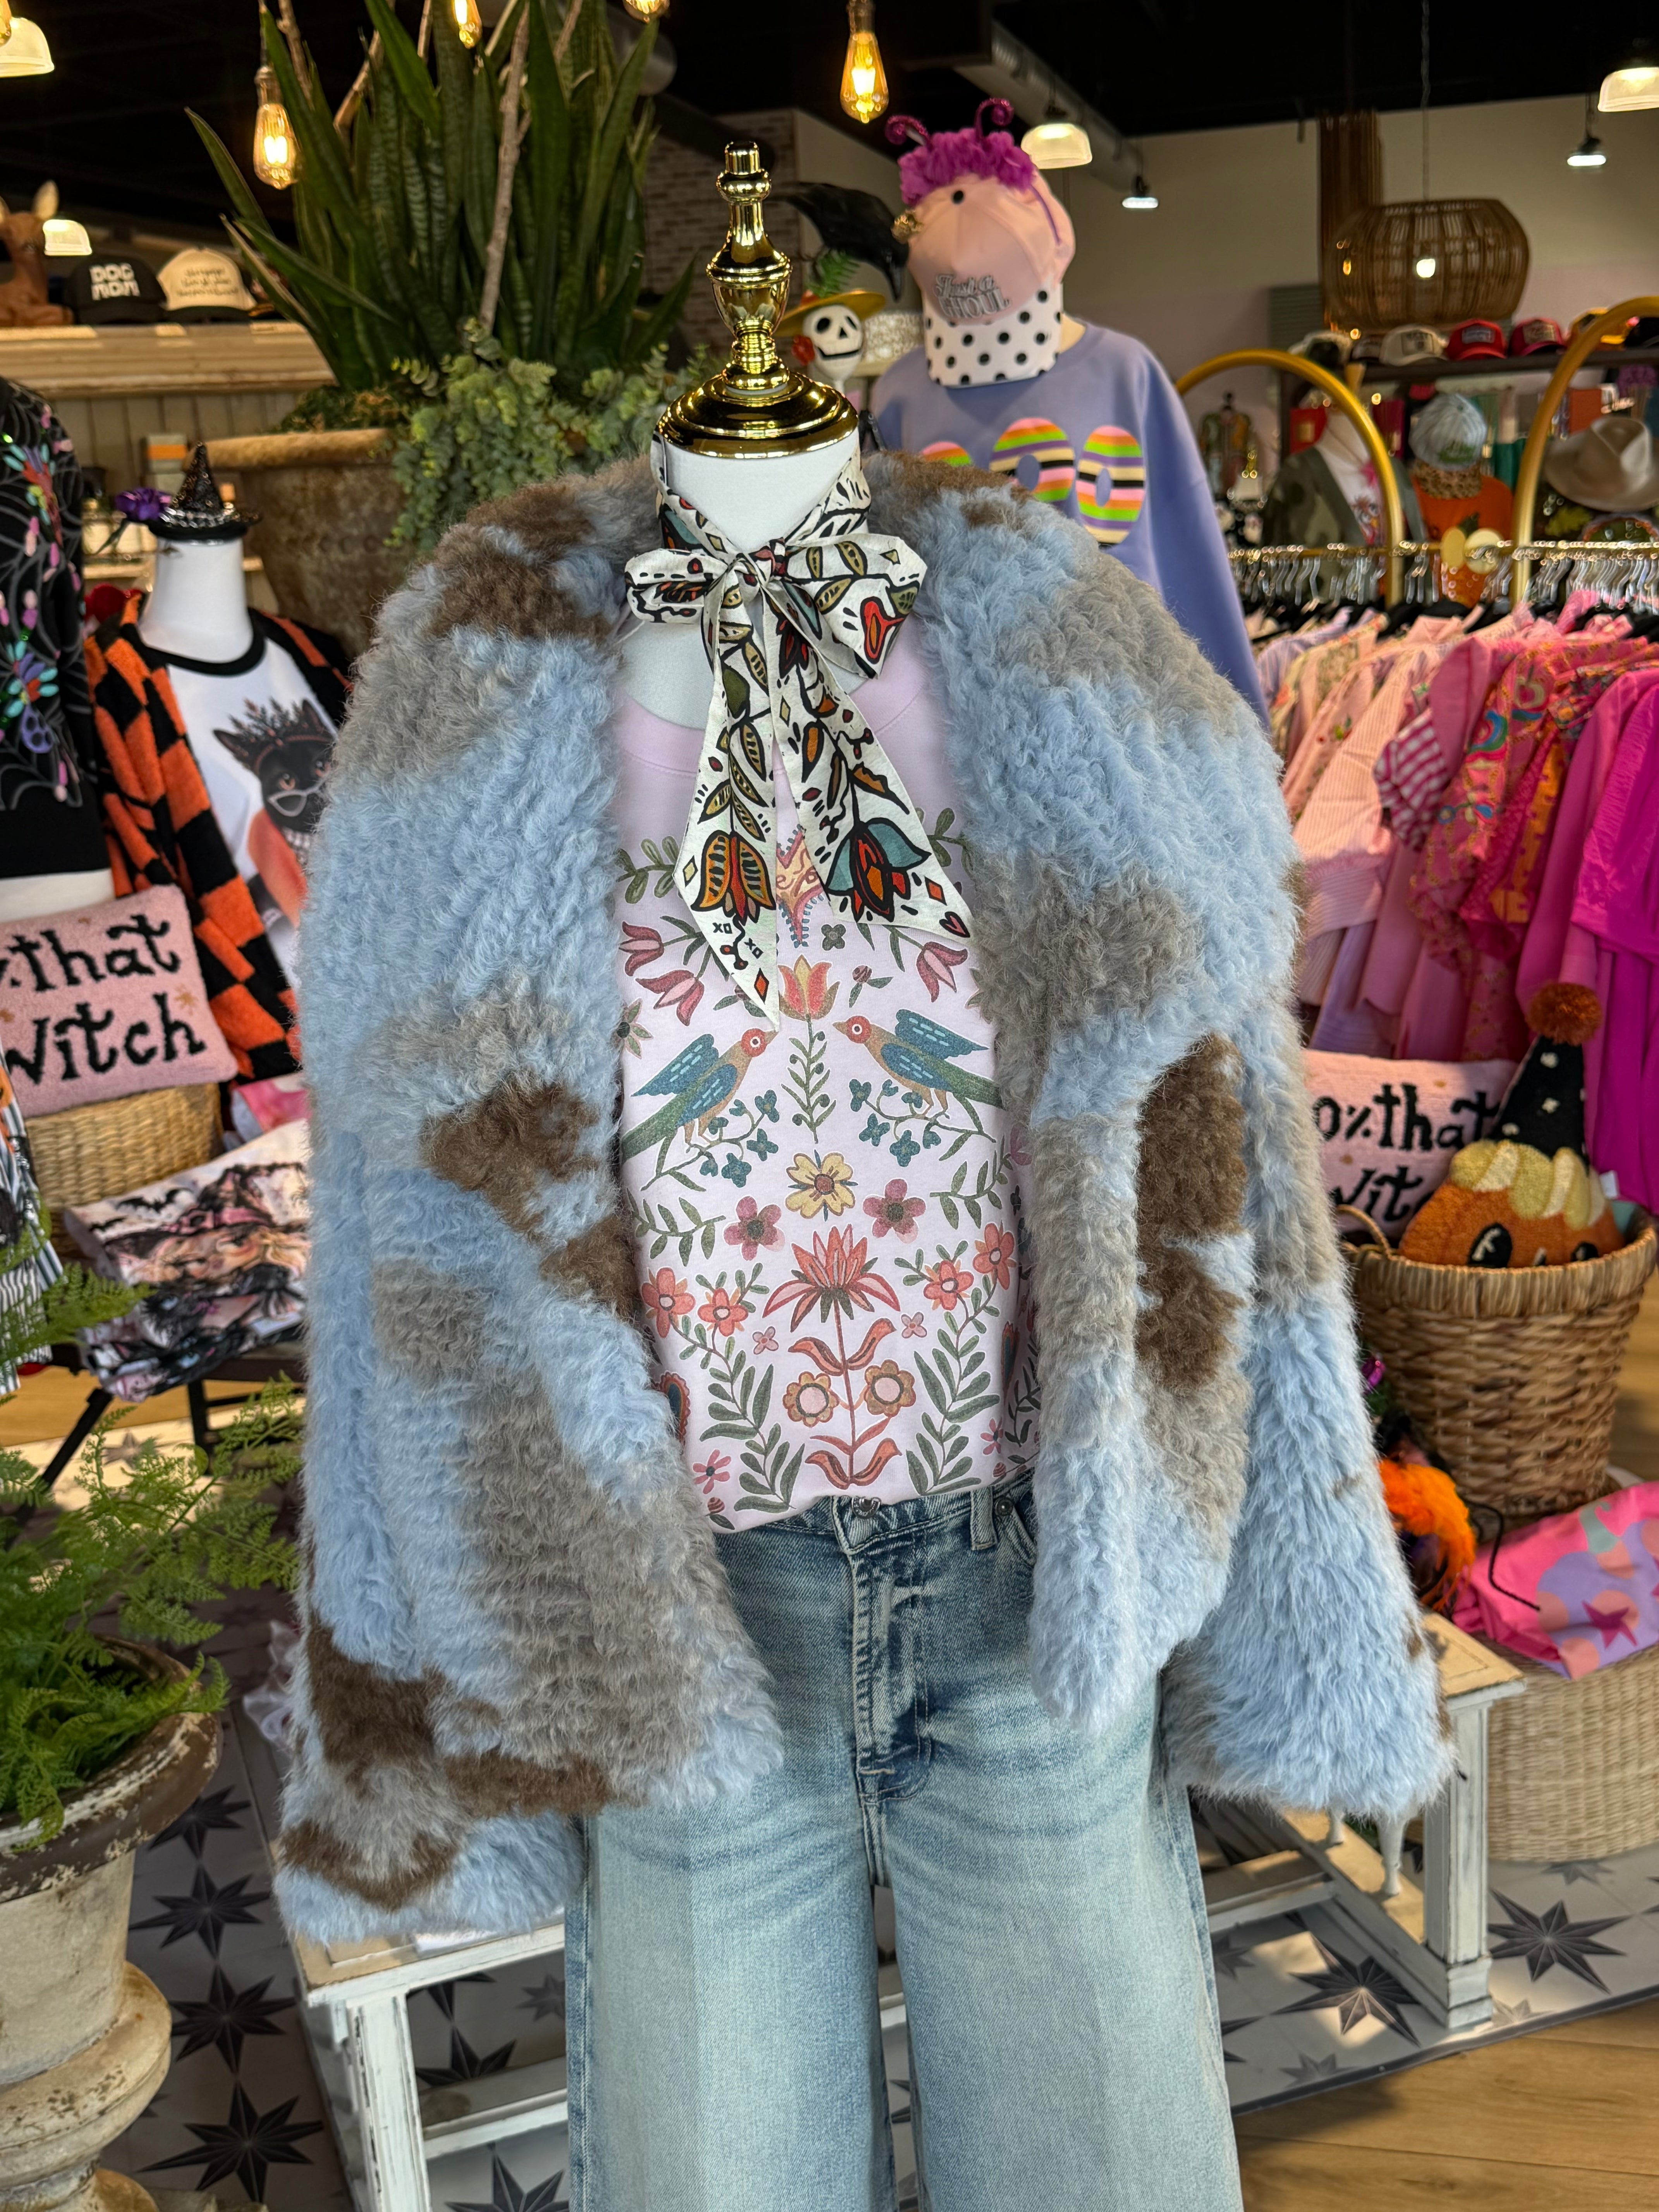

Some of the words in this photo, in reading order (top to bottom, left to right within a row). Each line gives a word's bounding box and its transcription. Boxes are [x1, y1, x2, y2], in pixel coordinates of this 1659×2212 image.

[89, 263, 135, 283] DOG
[91, 280, 141, 301] MOM
[7, 914, 181, 992] that
